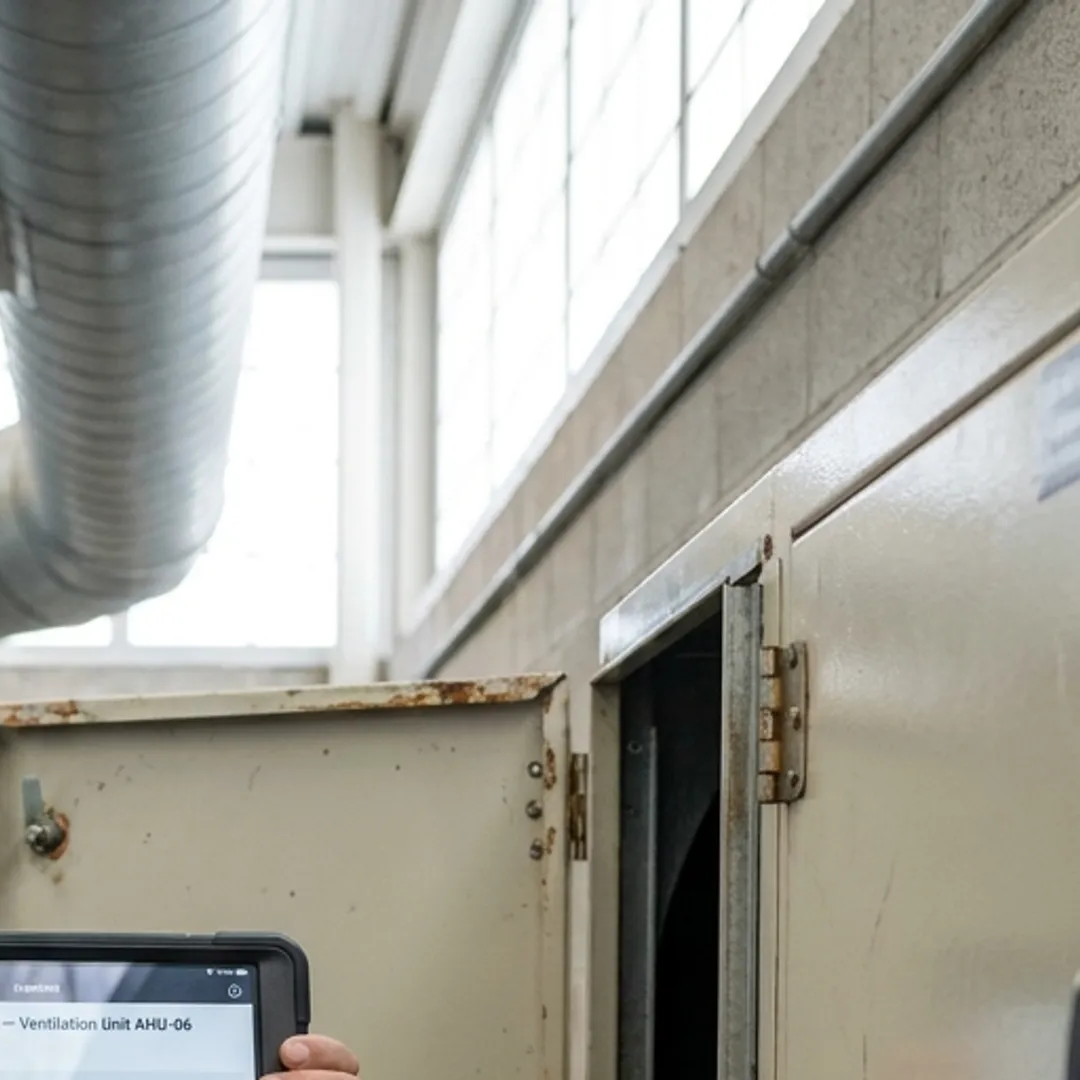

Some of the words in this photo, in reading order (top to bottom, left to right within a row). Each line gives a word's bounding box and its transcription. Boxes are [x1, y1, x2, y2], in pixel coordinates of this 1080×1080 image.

[19, 1016, 97, 1031] Ventilation
[101, 1017, 130, 1031] Unit
[135, 1017, 192, 1031] AHU-06
